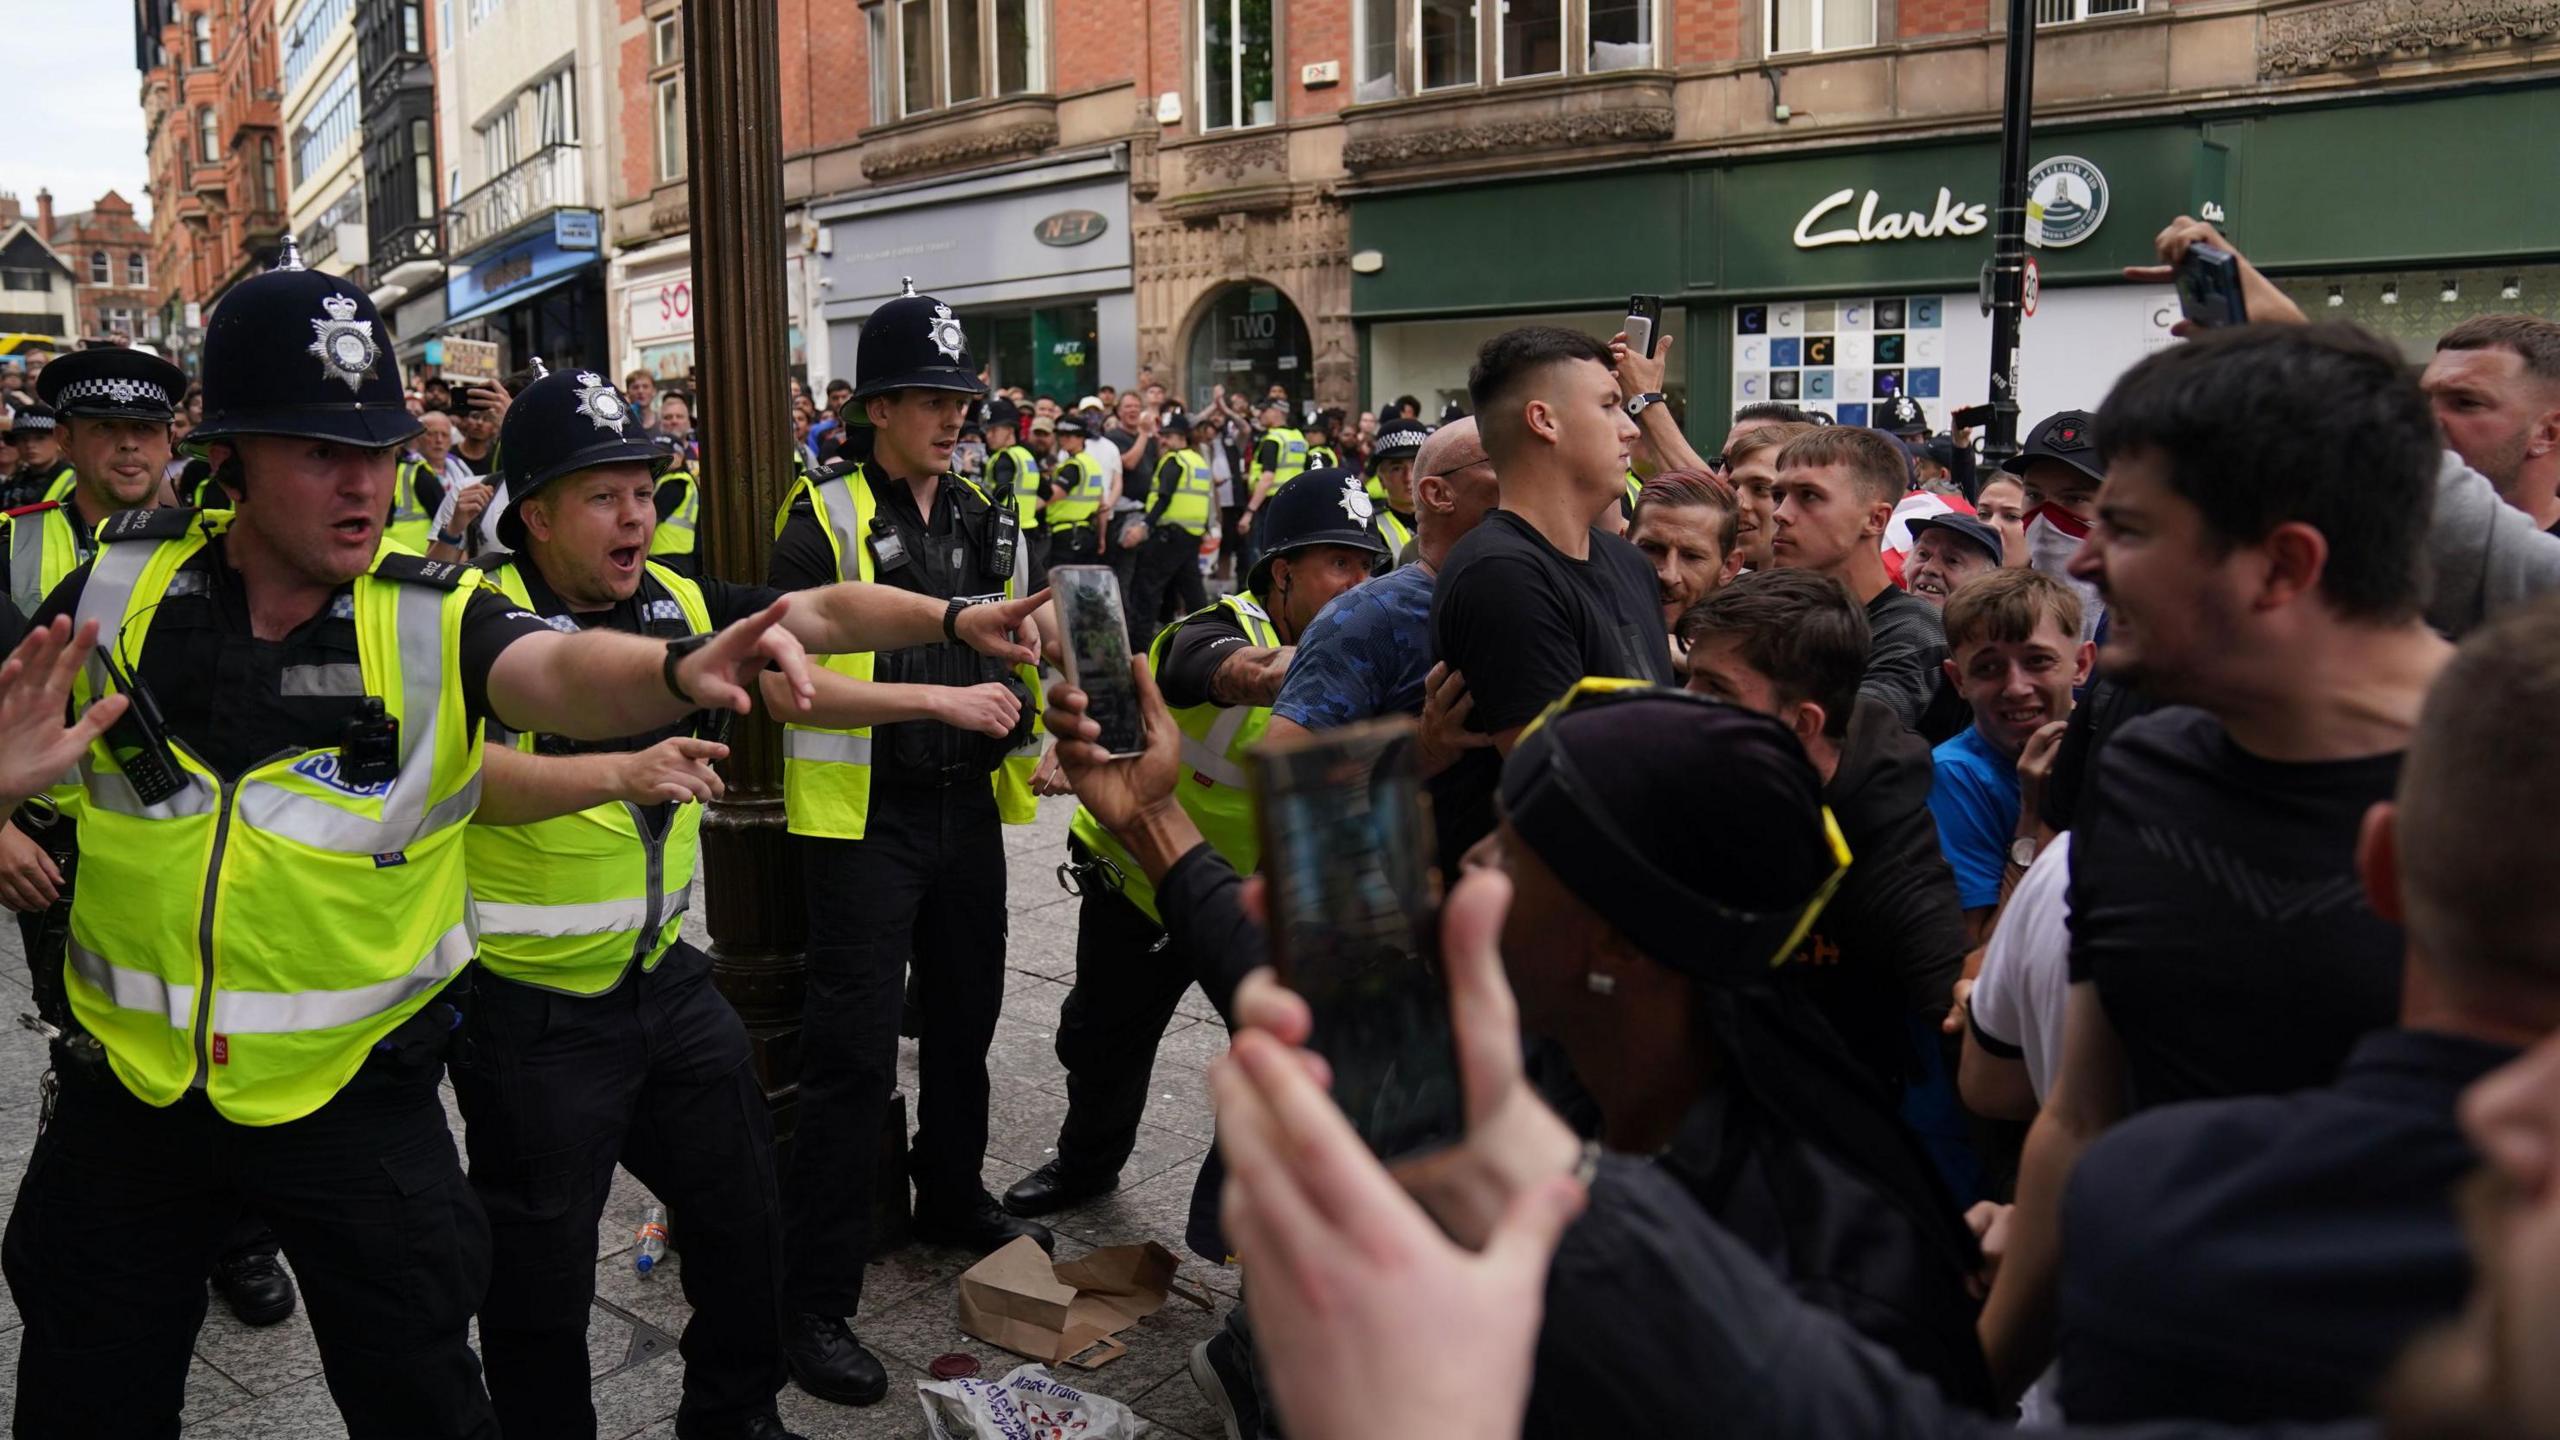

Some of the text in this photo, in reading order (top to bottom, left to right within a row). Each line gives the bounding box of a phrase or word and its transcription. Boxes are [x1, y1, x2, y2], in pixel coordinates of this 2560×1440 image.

[1045, 215, 1094, 239] NET
[1794, 186, 1988, 249] Clarks
[2026, 275, 2036, 300] 20
[1231, 314, 1276, 339] TWO
[1010, 1376, 1047, 1393] Made
